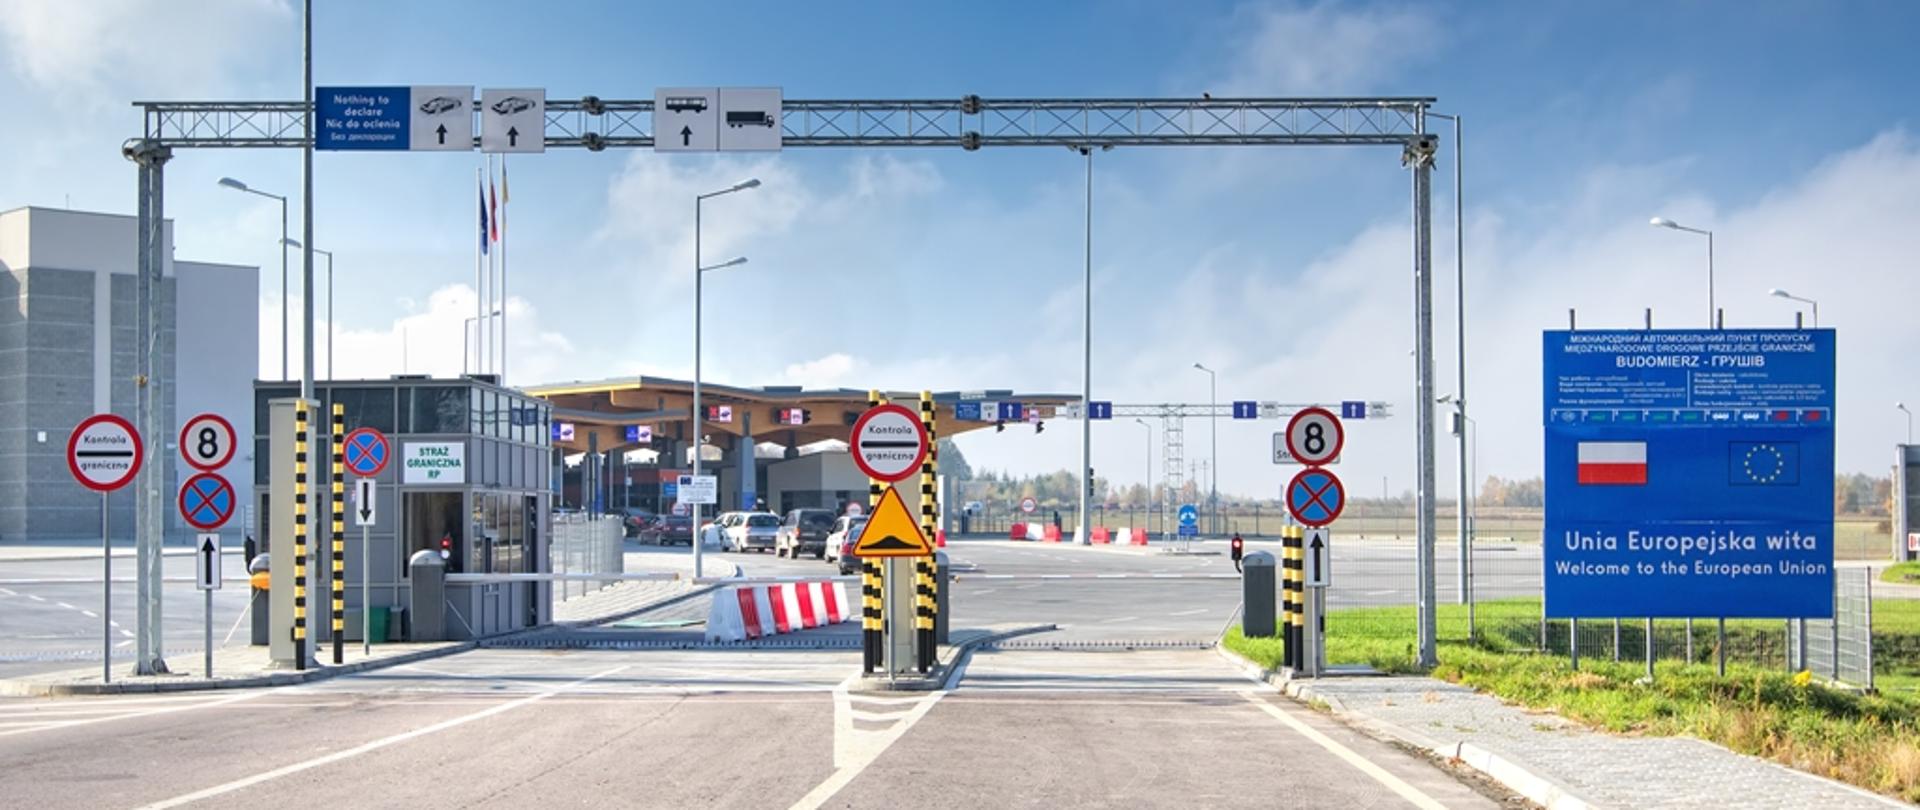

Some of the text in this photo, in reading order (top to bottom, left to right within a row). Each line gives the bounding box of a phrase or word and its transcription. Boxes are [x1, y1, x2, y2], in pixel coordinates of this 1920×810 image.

[334, 95, 389, 106] Nothing to
[344, 108, 383, 117] declare
[326, 119, 400, 129] Nic do oclenia
[1727, 334, 1758, 343] ПУНКТ
[1760, 333, 1812, 343] ПРОПУСКУ
[1656, 344, 1704, 353] DROGOWE
[1708, 342, 1759, 352] PRZEJŚCIE
[1761, 344, 1816, 352] GRANICZNE
[1616, 355, 1700, 368] BUDOMIERZ
[1711, 355, 1765, 367] ГРУШІВ
[869, 425, 913, 434] Kontrola
[84, 435, 126, 444] Kontrola
[198, 427, 218, 459] 8
[1304, 422, 1325, 455] 8
[419, 446, 449, 457] STRAŻ
[866, 451, 915, 462] graniczna
[81, 460, 129, 471] graniczna
[407, 458, 461, 468] GRANICZNA
[428, 470, 440, 479] RP
[1565, 530, 1816, 555] Unia Europejska wita
[1555, 560, 1827, 578] Welcome to the European Union
